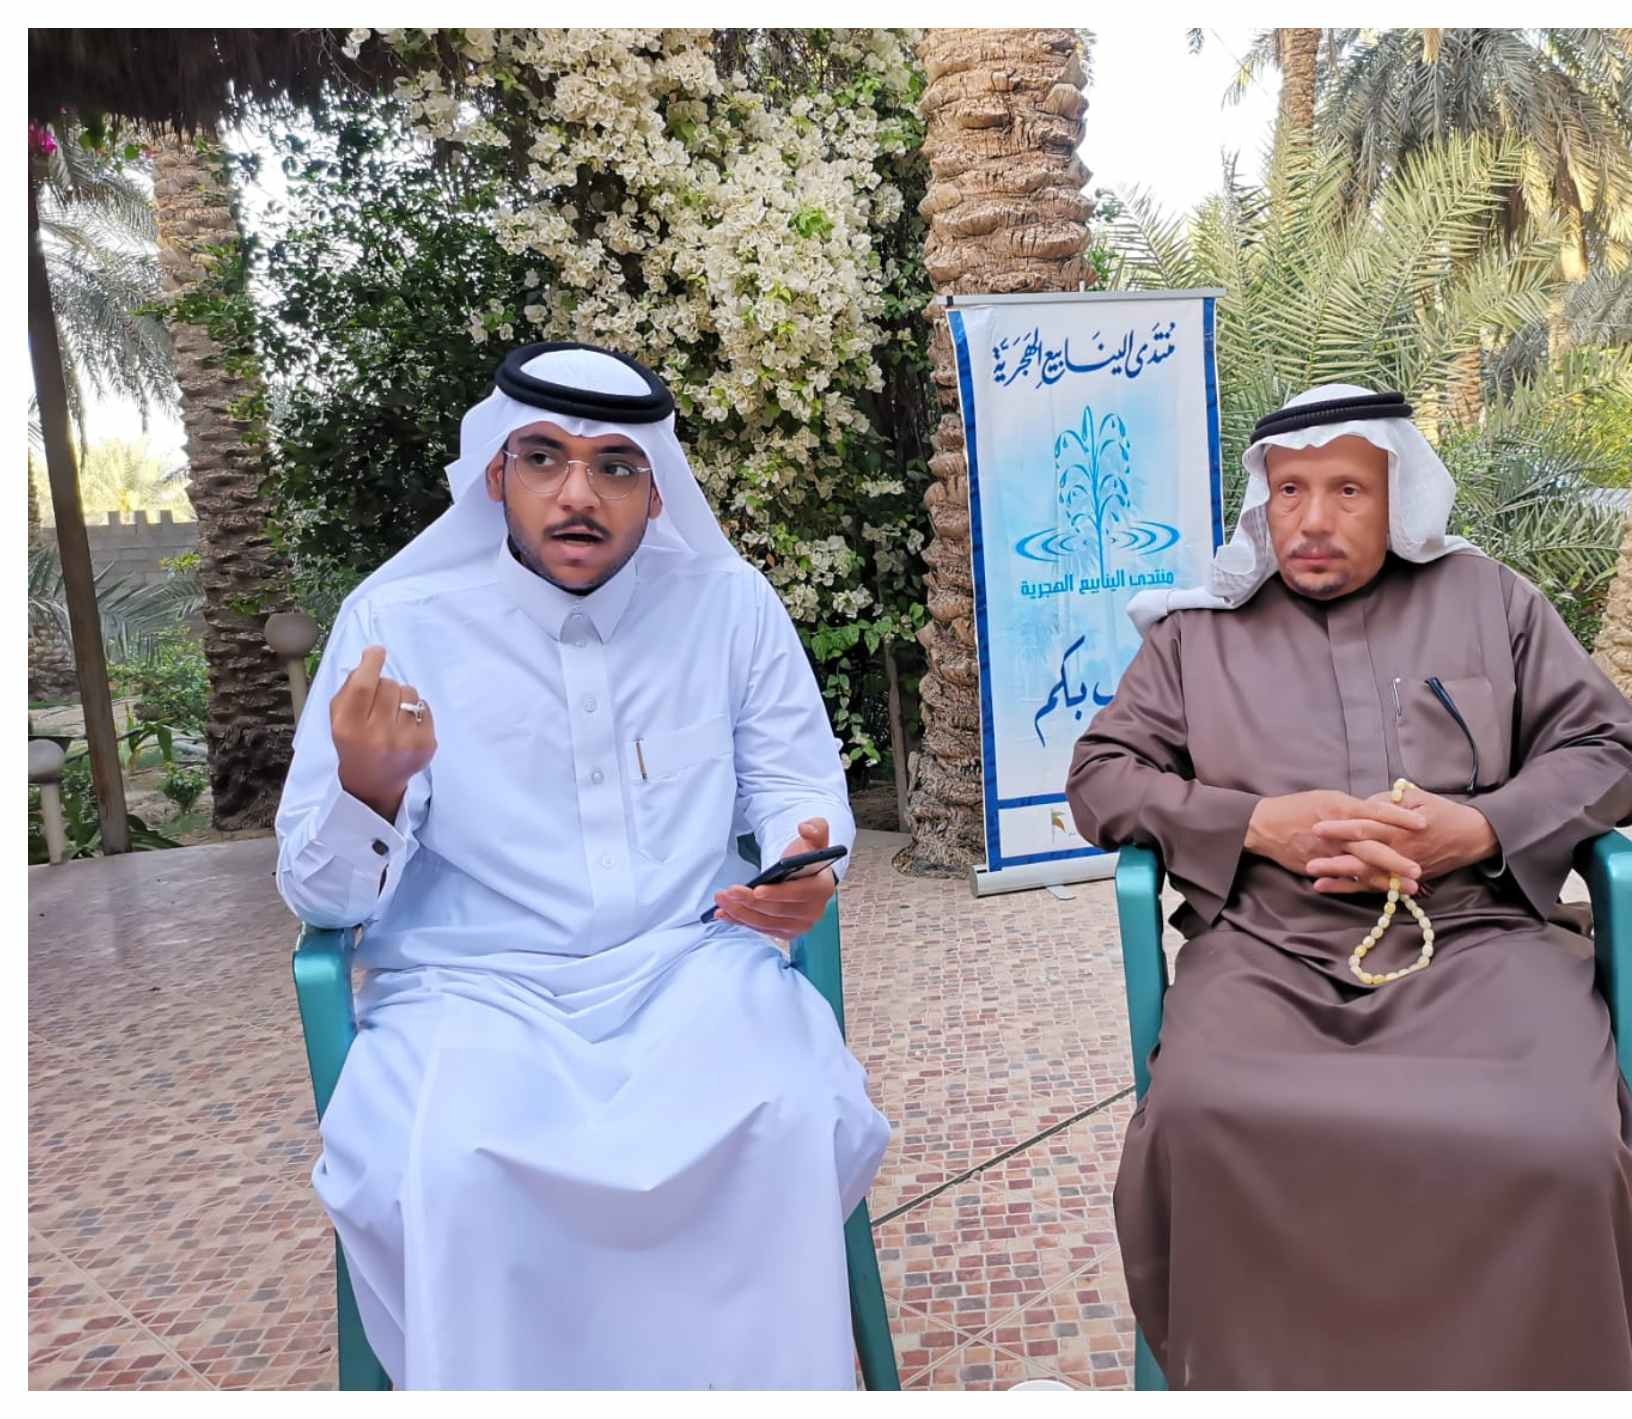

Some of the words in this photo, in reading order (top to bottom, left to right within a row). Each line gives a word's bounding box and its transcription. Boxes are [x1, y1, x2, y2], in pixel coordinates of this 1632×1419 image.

[1020, 576, 1074, 598] الهجرية
[1078, 570, 1126, 593] الينابيع
[1129, 569, 1175, 587] منتدى
[1034, 634, 1087, 748] بكم
